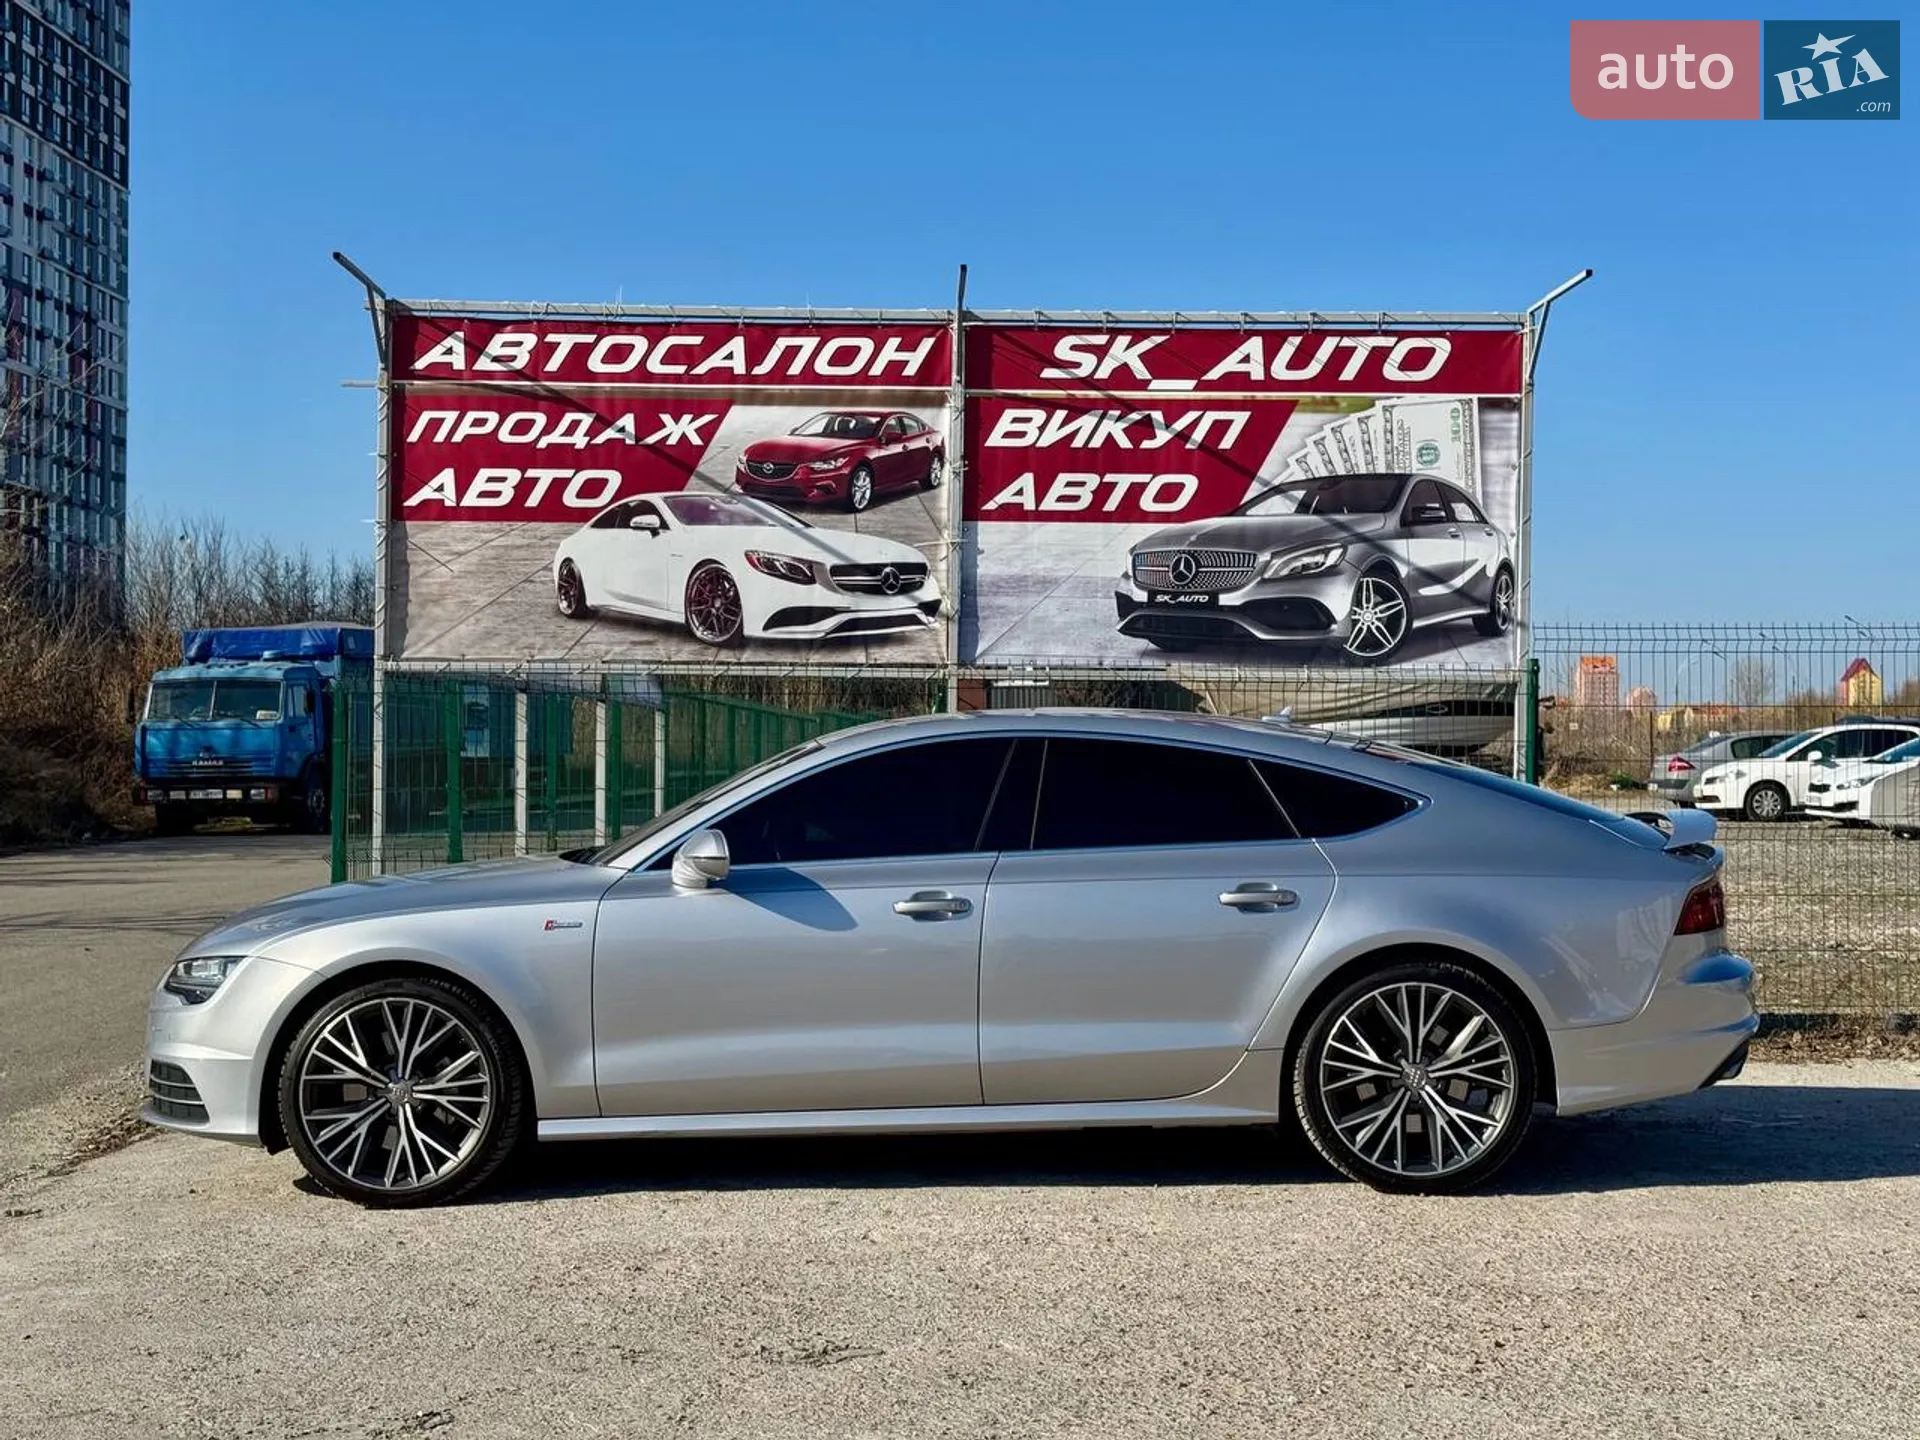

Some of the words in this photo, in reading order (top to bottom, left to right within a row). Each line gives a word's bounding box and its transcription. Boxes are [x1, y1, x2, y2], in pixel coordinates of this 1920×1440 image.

[410, 331, 936, 377] АВТОСАЛОН
[1039, 334, 1452, 391] SK_AUTO
[406, 410, 719, 450] ПРОДАЖ
[984, 408, 1252, 450] ВИКУП
[402, 467, 623, 509] АВТО
[981, 472, 1199, 513] АВТО
[1155, 594, 1209, 604] SK_AUTO
